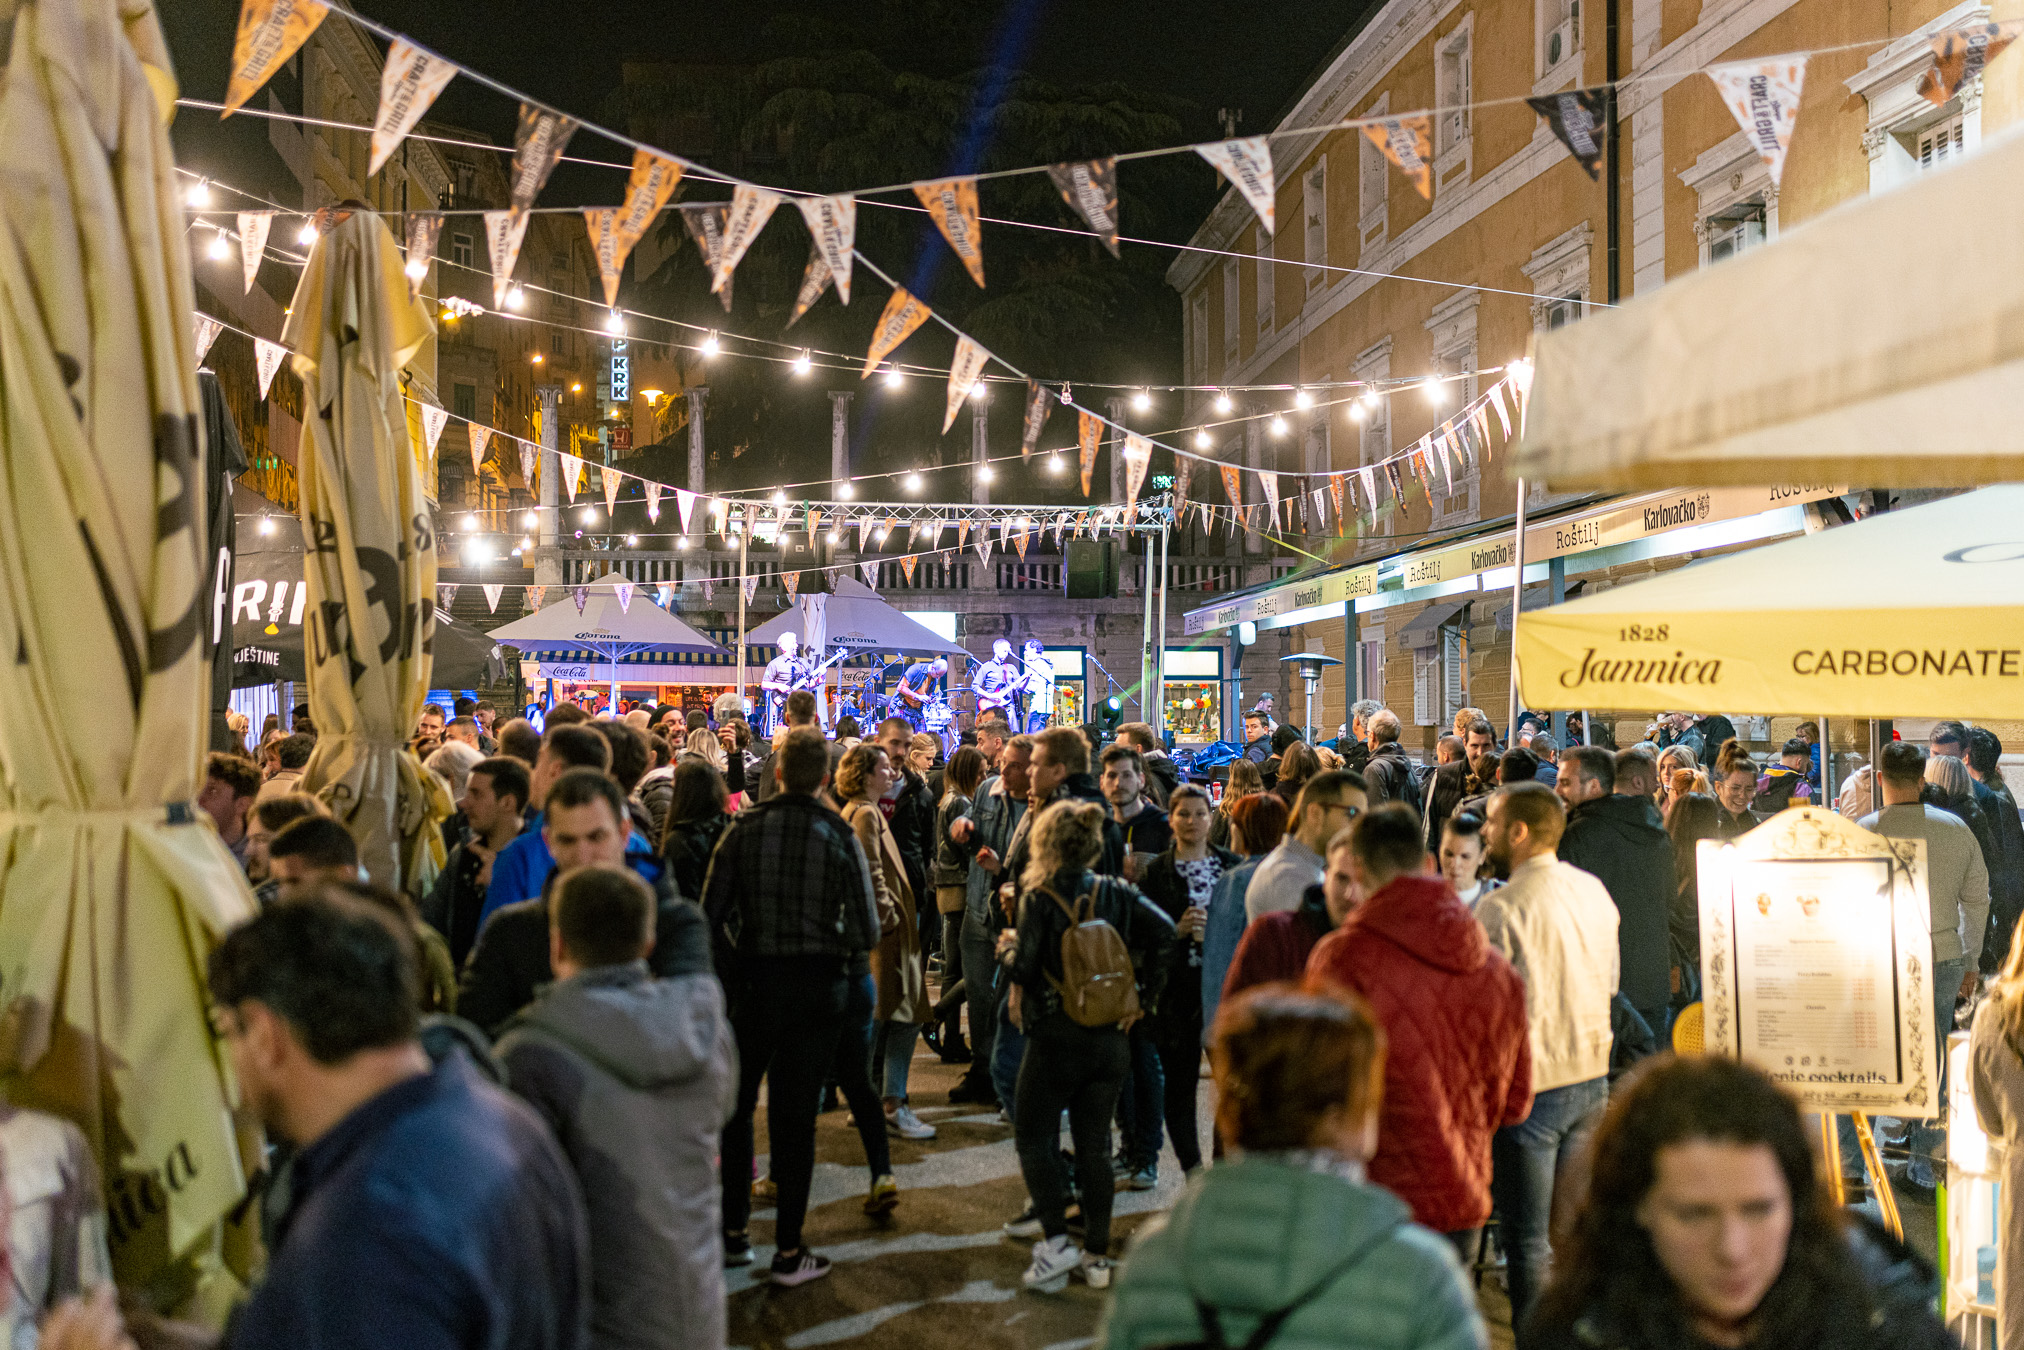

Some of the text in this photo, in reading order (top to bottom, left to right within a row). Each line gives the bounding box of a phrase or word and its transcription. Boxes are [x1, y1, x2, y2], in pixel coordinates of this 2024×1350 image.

[612, 357, 627, 399] KRK
[1410, 561, 1441, 583] Roštilj
[1471, 543, 1507, 571] Karlovačko
[1556, 522, 1599, 550] Roštilj
[1643, 498, 1696, 532] Karlovačko
[1345, 568, 1372, 595] Roštilj
[574, 632, 621, 641] Corona
[833, 636, 879, 644] Corona
[1618, 624, 1670, 642] 1828
[1558, 647, 1722, 689] Jamnica
[1792, 649, 2024, 677] CARBONATE
